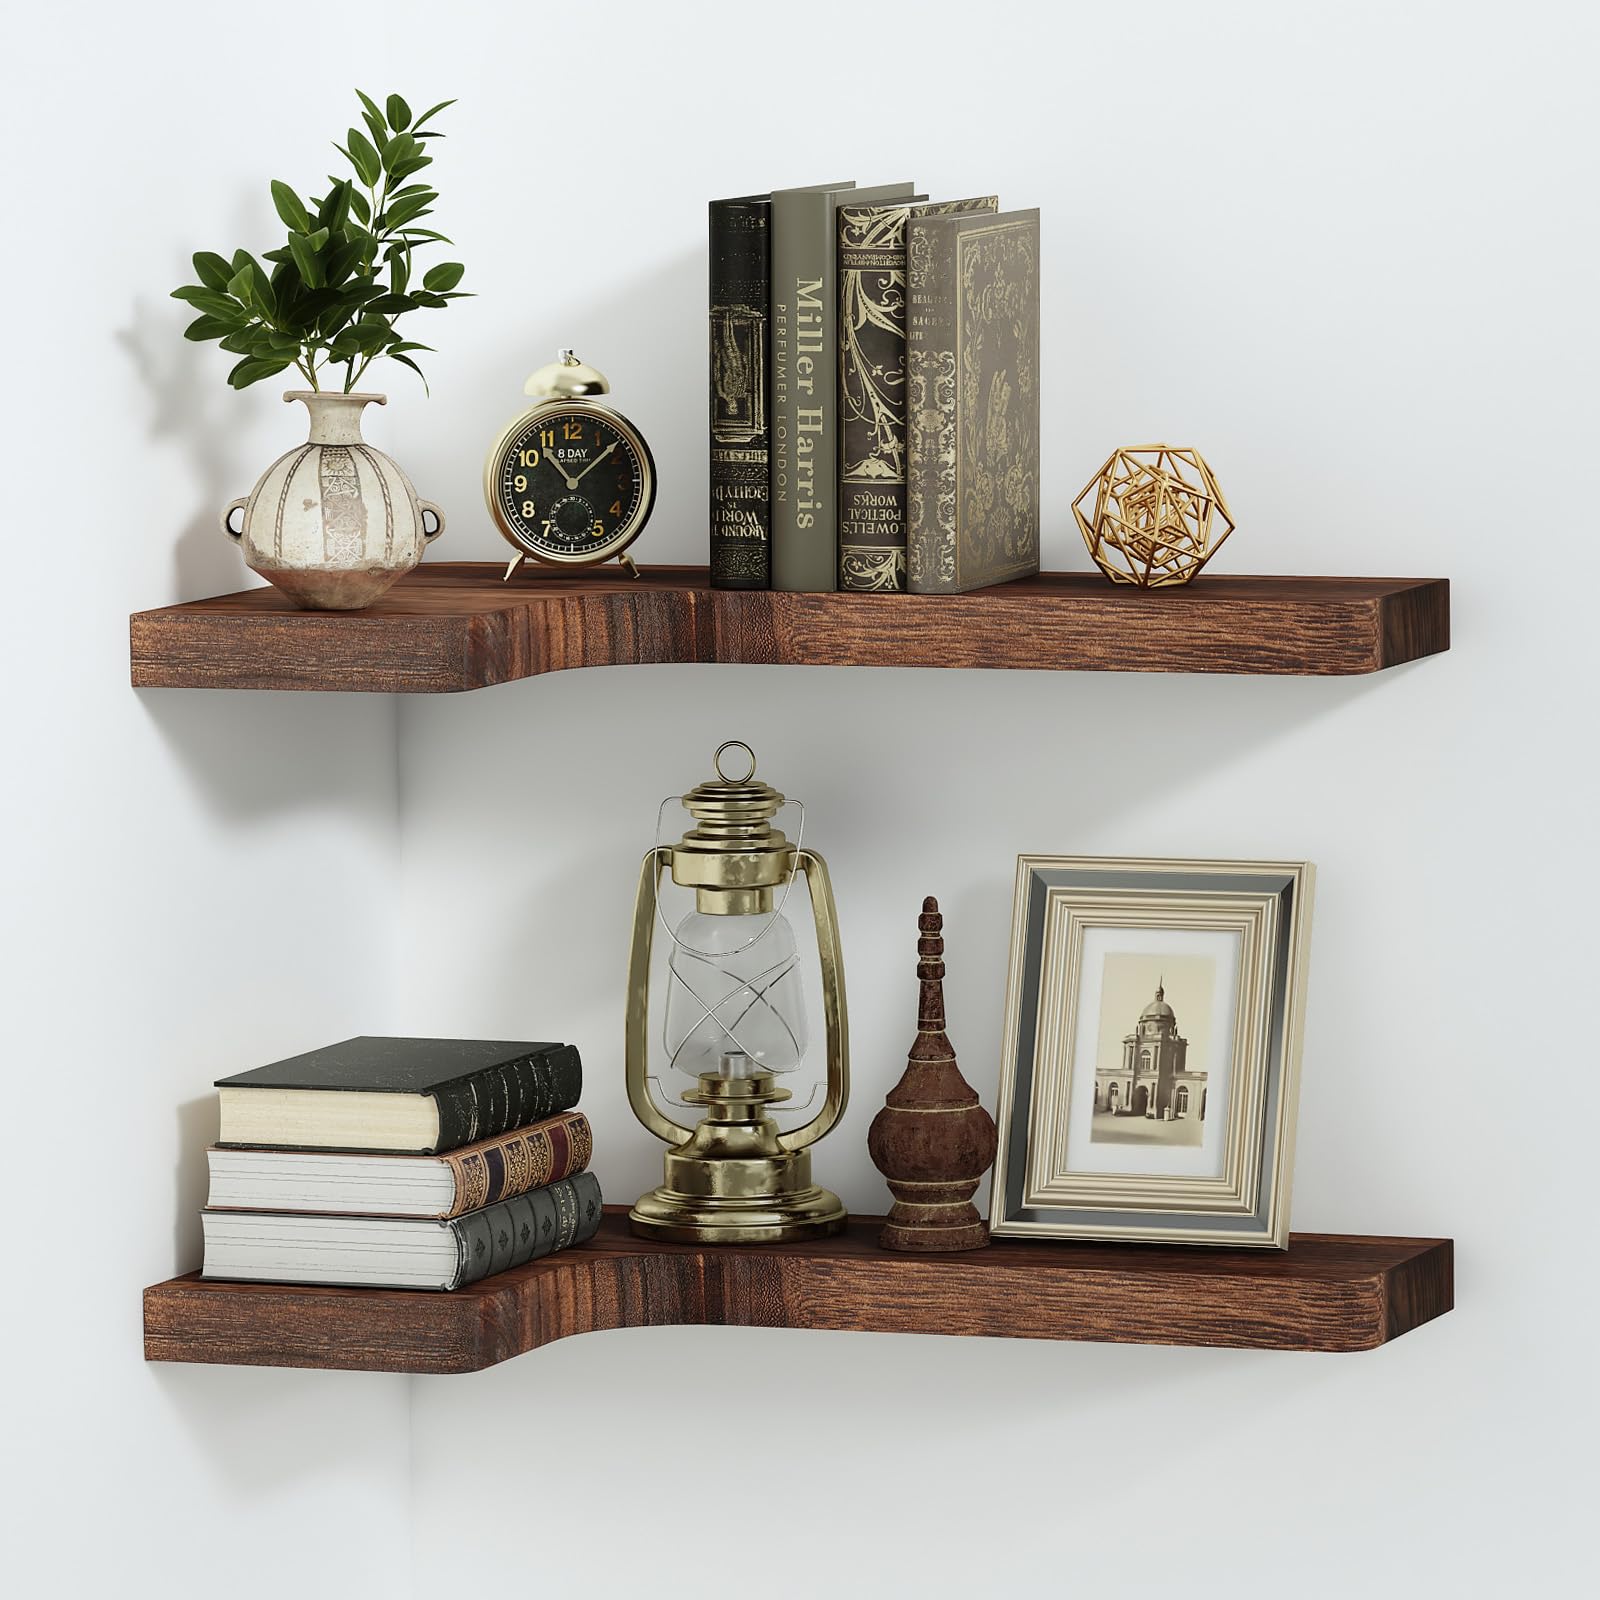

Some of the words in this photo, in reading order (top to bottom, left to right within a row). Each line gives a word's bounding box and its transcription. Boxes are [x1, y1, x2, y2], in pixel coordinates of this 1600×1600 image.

[796, 277, 824, 396] Miller
[775, 304, 787, 407] PERFUMER
[540, 430, 554, 447] 11
[563, 423, 583, 440] 12
[594, 432, 601, 447] 1
[518, 449, 539, 468] 10
[558, 449, 565, 458] 8
[568, 449, 587, 458] DAY
[775, 415, 788, 504] LONDON
[796, 406, 824, 530] Harris
[513, 474, 528, 493] 9
[853, 490, 898, 507] WORKS
[521, 500, 536, 518] 8
[609, 500, 623, 517] 4
[847, 508, 902, 521] POETICAL
[541, 520, 552, 538] 7
[591, 520, 605, 537] 5
[842, 521, 907, 535] LOWELL'S
